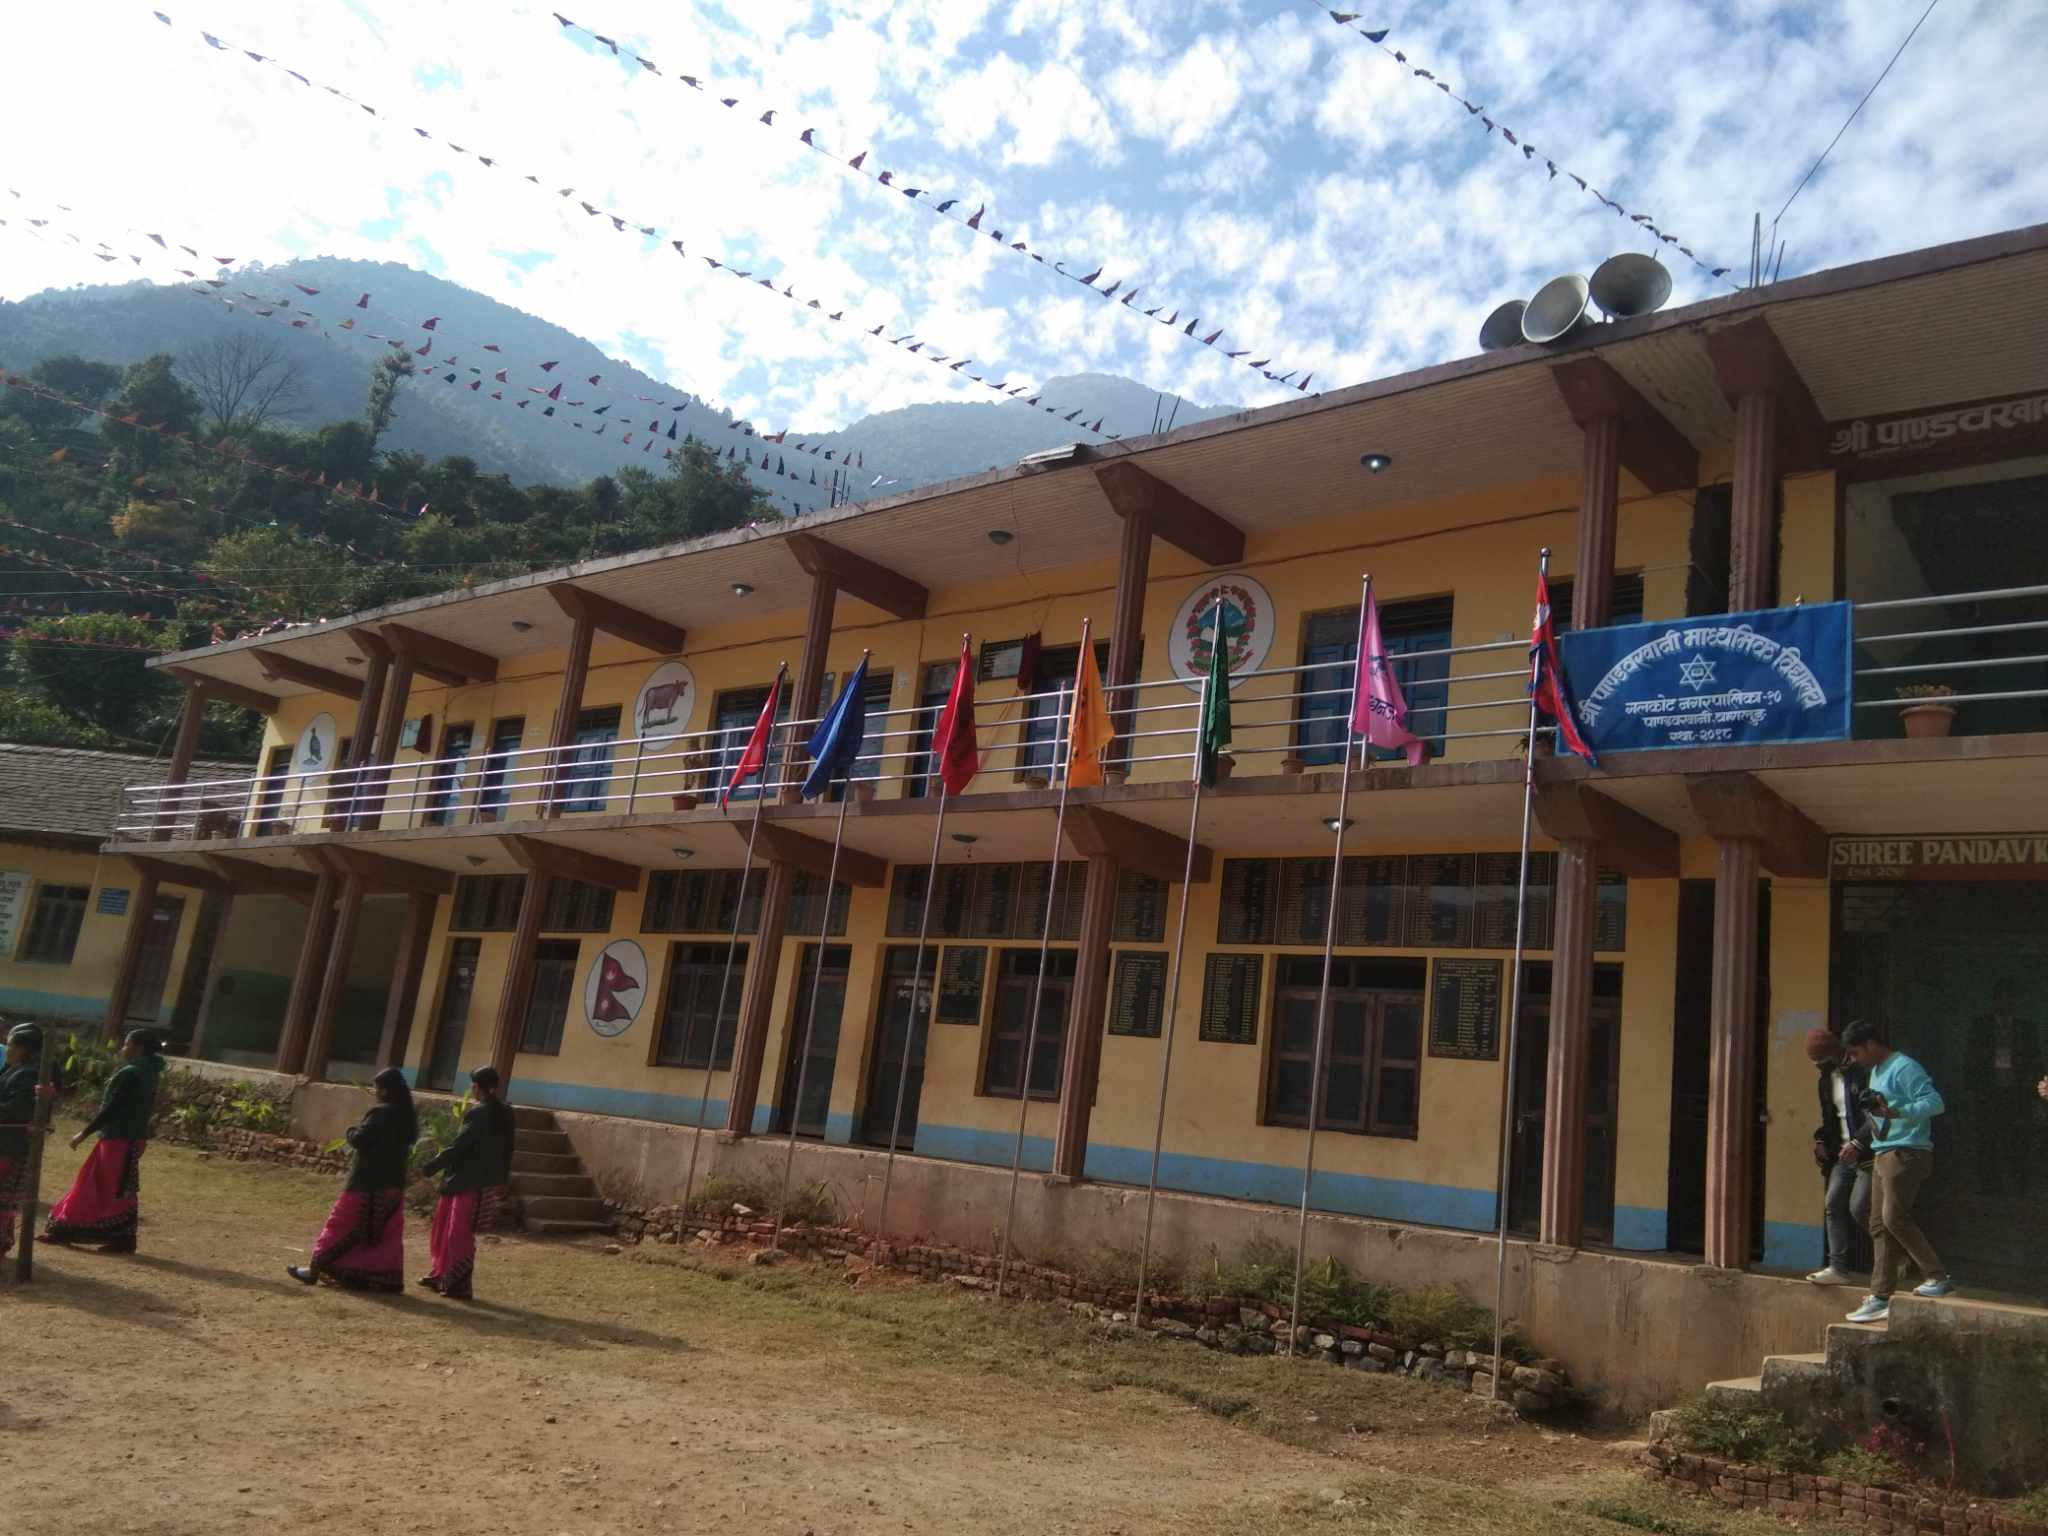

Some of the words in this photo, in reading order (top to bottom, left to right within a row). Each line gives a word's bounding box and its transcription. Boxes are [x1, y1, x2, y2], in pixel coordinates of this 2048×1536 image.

[1828, 420, 1870, 454] श्री
[1682, 623, 1781, 664] माध्यमिक
[1589, 629, 1682, 701] पाण्डवखानी
[1771, 646, 1828, 711] विद्यालय
[1578, 697, 1603, 727] श्री
[1625, 694, 1677, 714] गलकोट
[1833, 842, 1914, 865] SHREE
